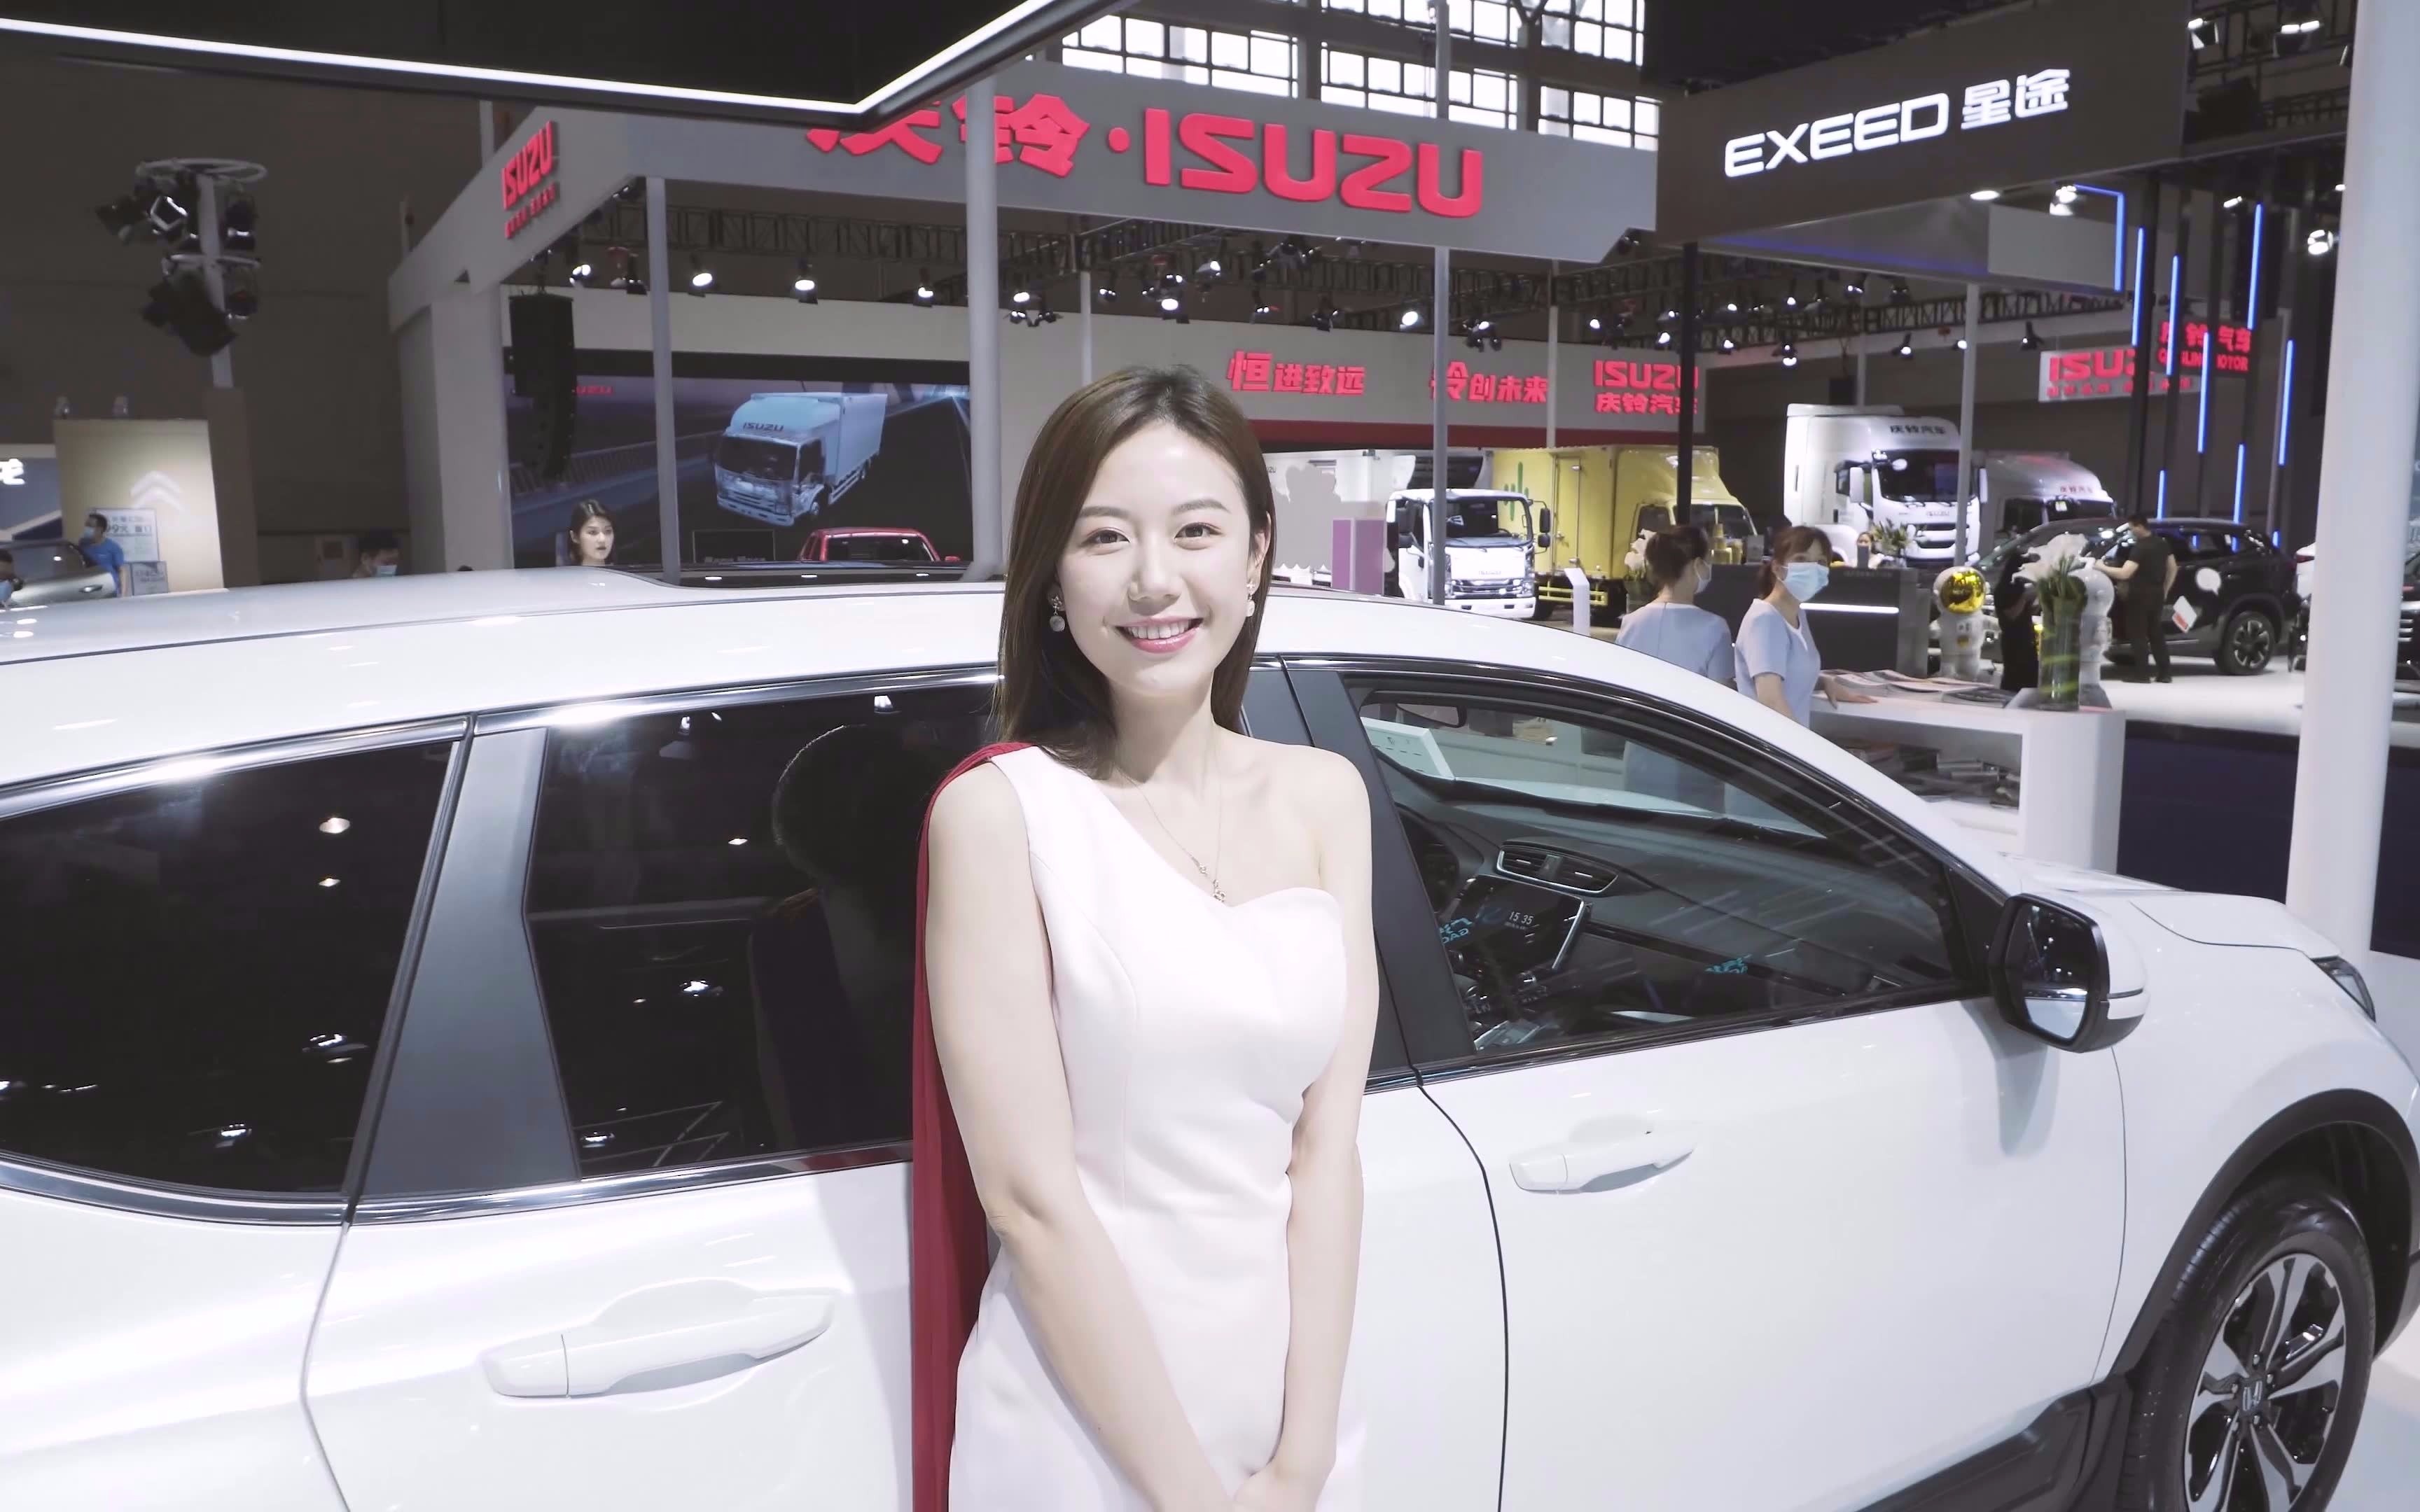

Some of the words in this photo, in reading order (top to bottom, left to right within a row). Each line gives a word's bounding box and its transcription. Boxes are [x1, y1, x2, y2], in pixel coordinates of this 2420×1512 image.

[1725, 92, 1949, 177] EXEED
[1961, 69, 2071, 130] 星途
[501, 120, 554, 211] ISUZU
[1144, 107, 1483, 218] ISUZU
[1228, 349, 1365, 396] 恒进致远
[2049, 349, 2136, 382] ISU
[742, 421, 784, 432] ISUZU
